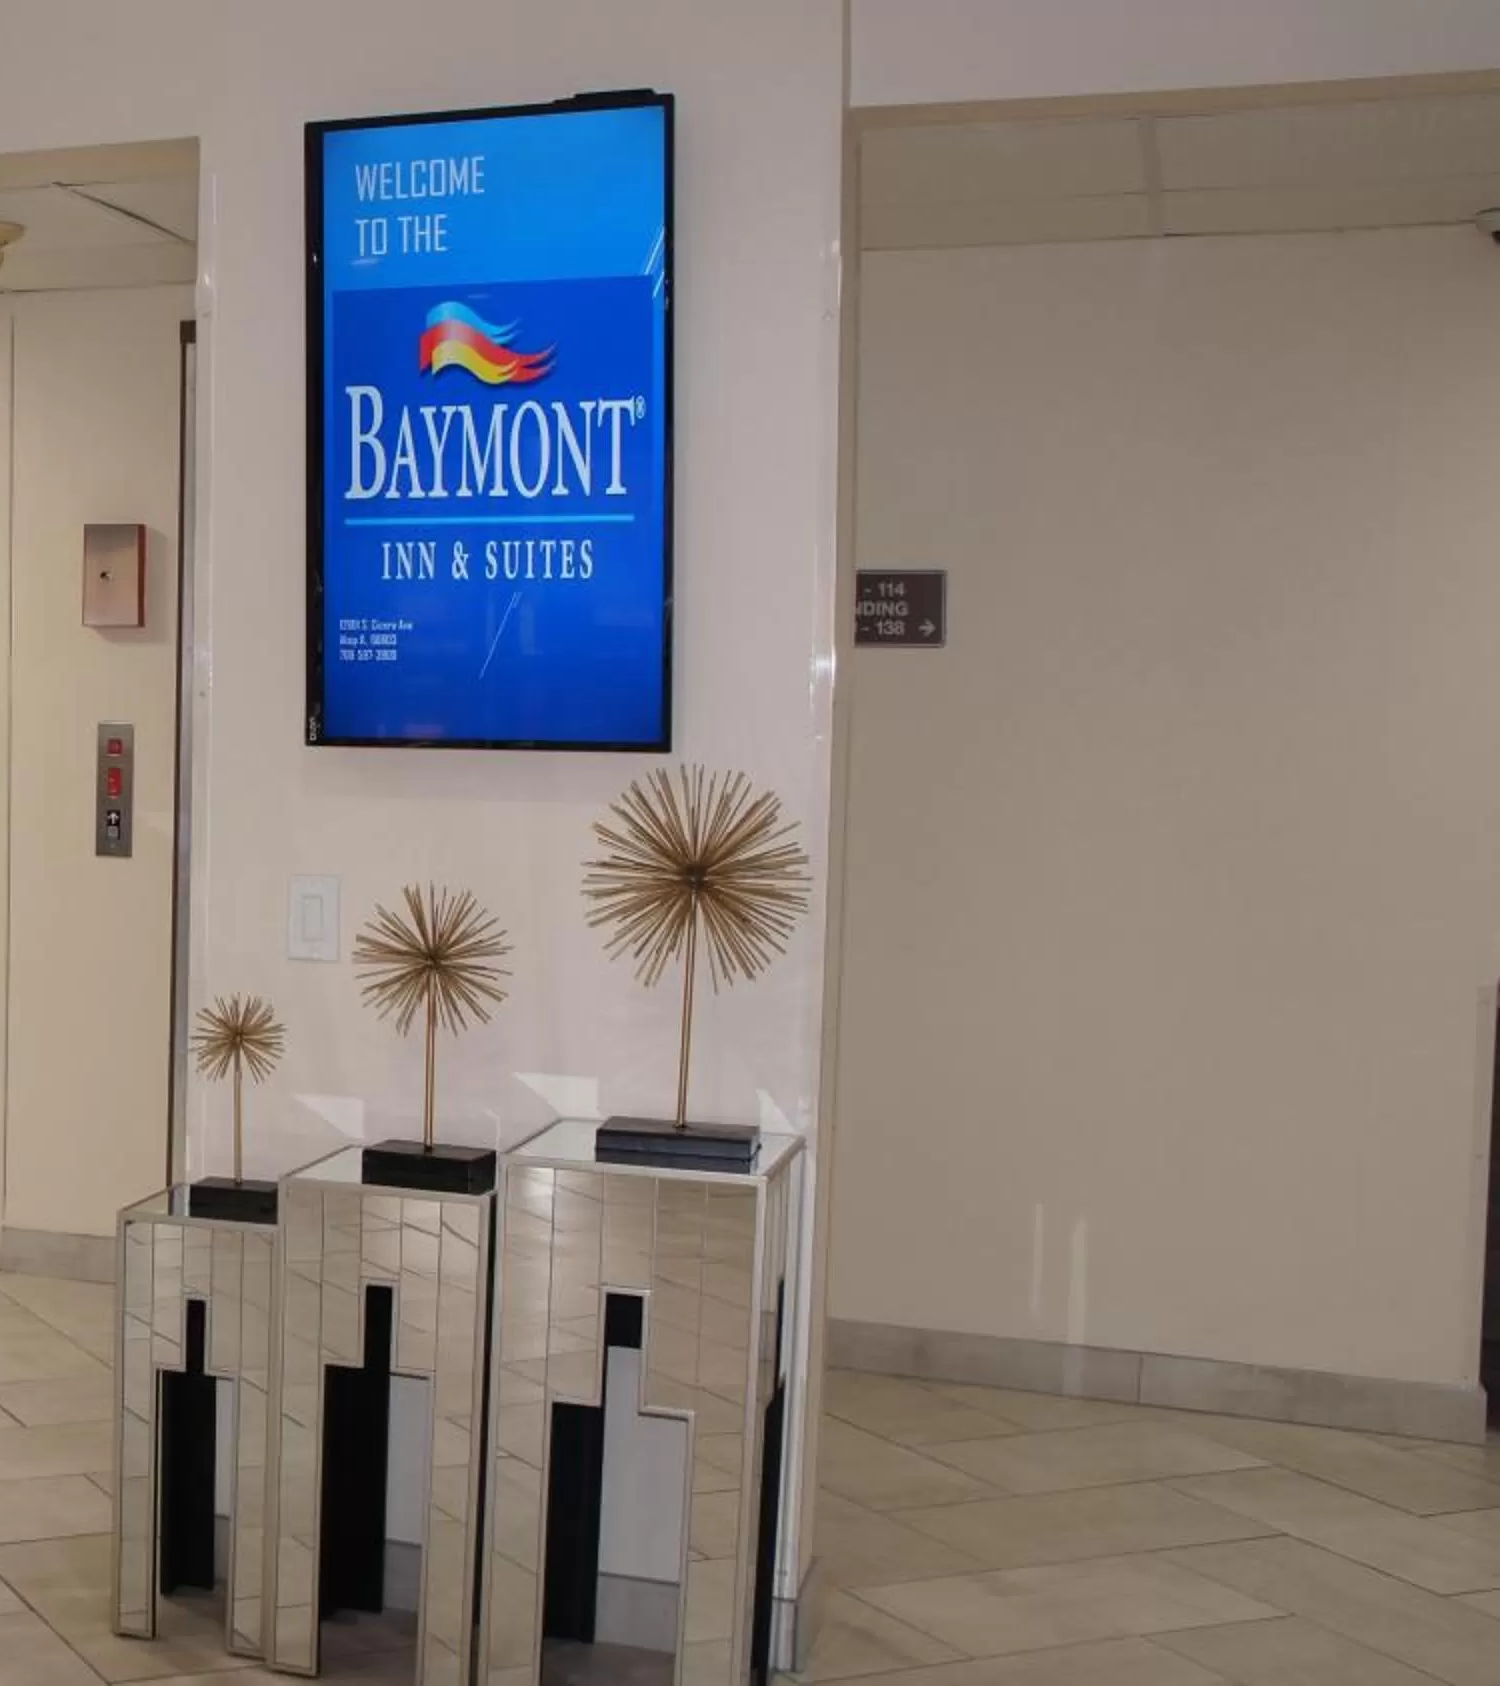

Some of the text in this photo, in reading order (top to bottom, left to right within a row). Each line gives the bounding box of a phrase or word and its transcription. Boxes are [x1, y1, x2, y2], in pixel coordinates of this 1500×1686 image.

[354, 155, 486, 202] WELCOME
[354, 213, 449, 257] TO THE
[344, 385, 637, 499] BAYMONT
[381, 539, 595, 581] INN & SUITES
[878, 581, 905, 598] 114
[876, 619, 905, 636] 138
